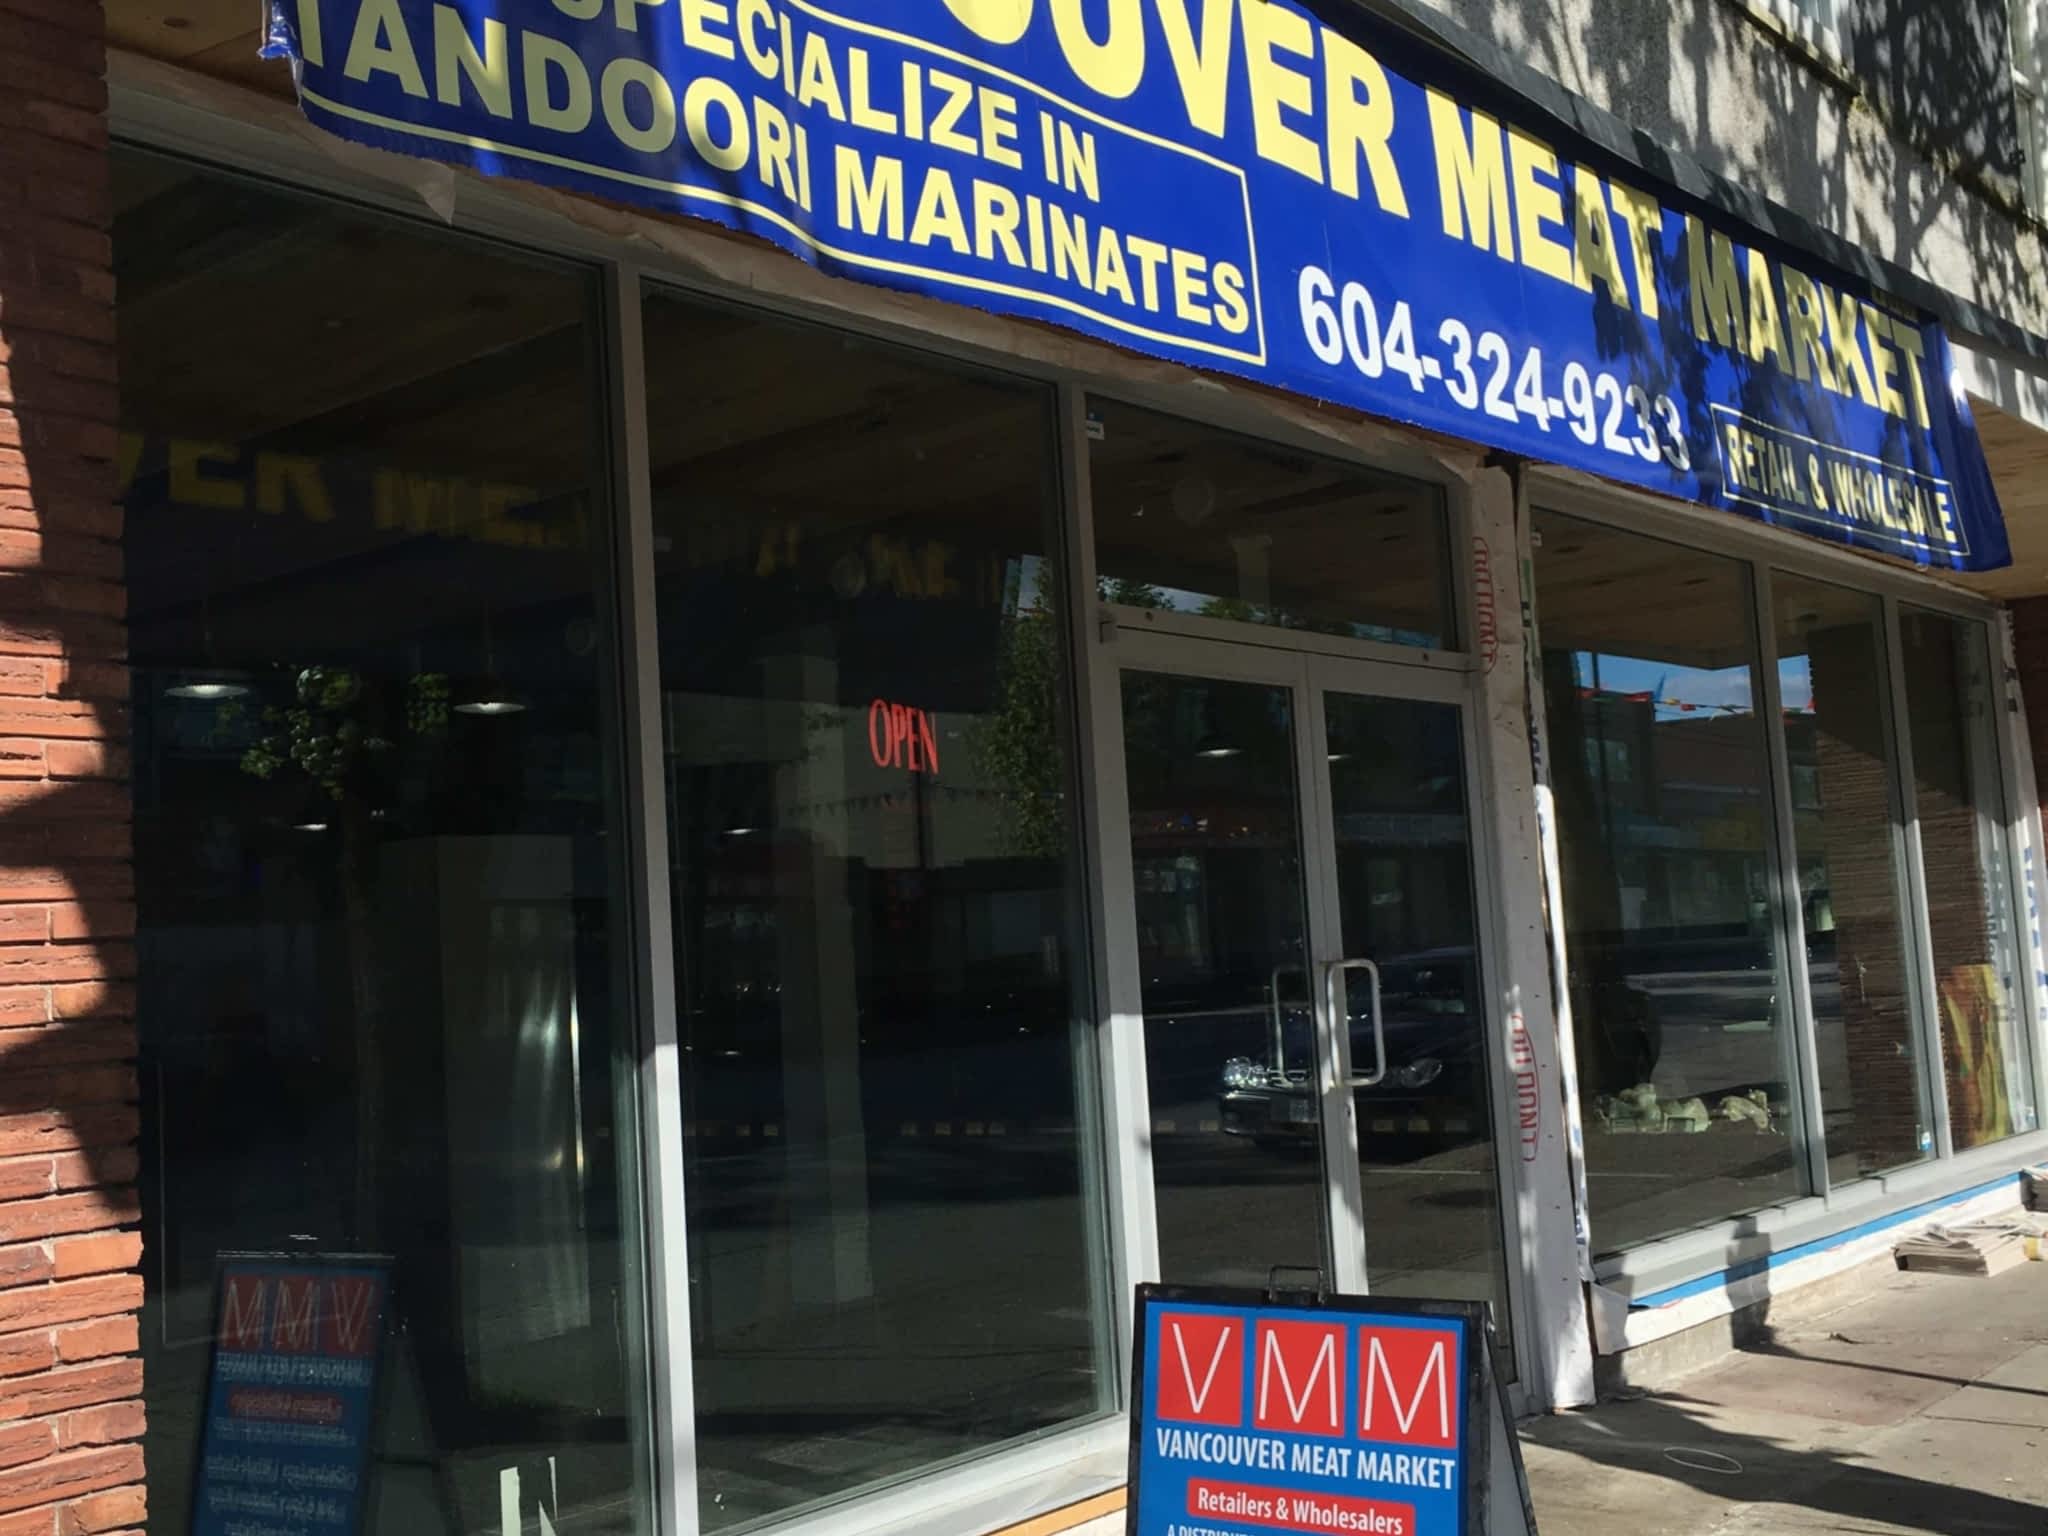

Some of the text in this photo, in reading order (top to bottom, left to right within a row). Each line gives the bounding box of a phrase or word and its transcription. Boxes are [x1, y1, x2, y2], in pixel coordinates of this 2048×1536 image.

[1040, 111, 1099, 202] IN
[834, 144, 1250, 334] MARINATES
[1426, 83, 1662, 319] MEAT
[1685, 210, 1931, 431] MARKET
[1299, 264, 1690, 470] 604-324-9233
[1725, 423, 1957, 543] RETAIL & WHOLESALE
[868, 699, 939, 774] OPEN
[1172, 1322, 1449, 1438] VMM
[1156, 1428, 1456, 1490] VANCOUVER MEAT MARKET
[1198, 1487, 1403, 1535] Retailers & Wholesalers
